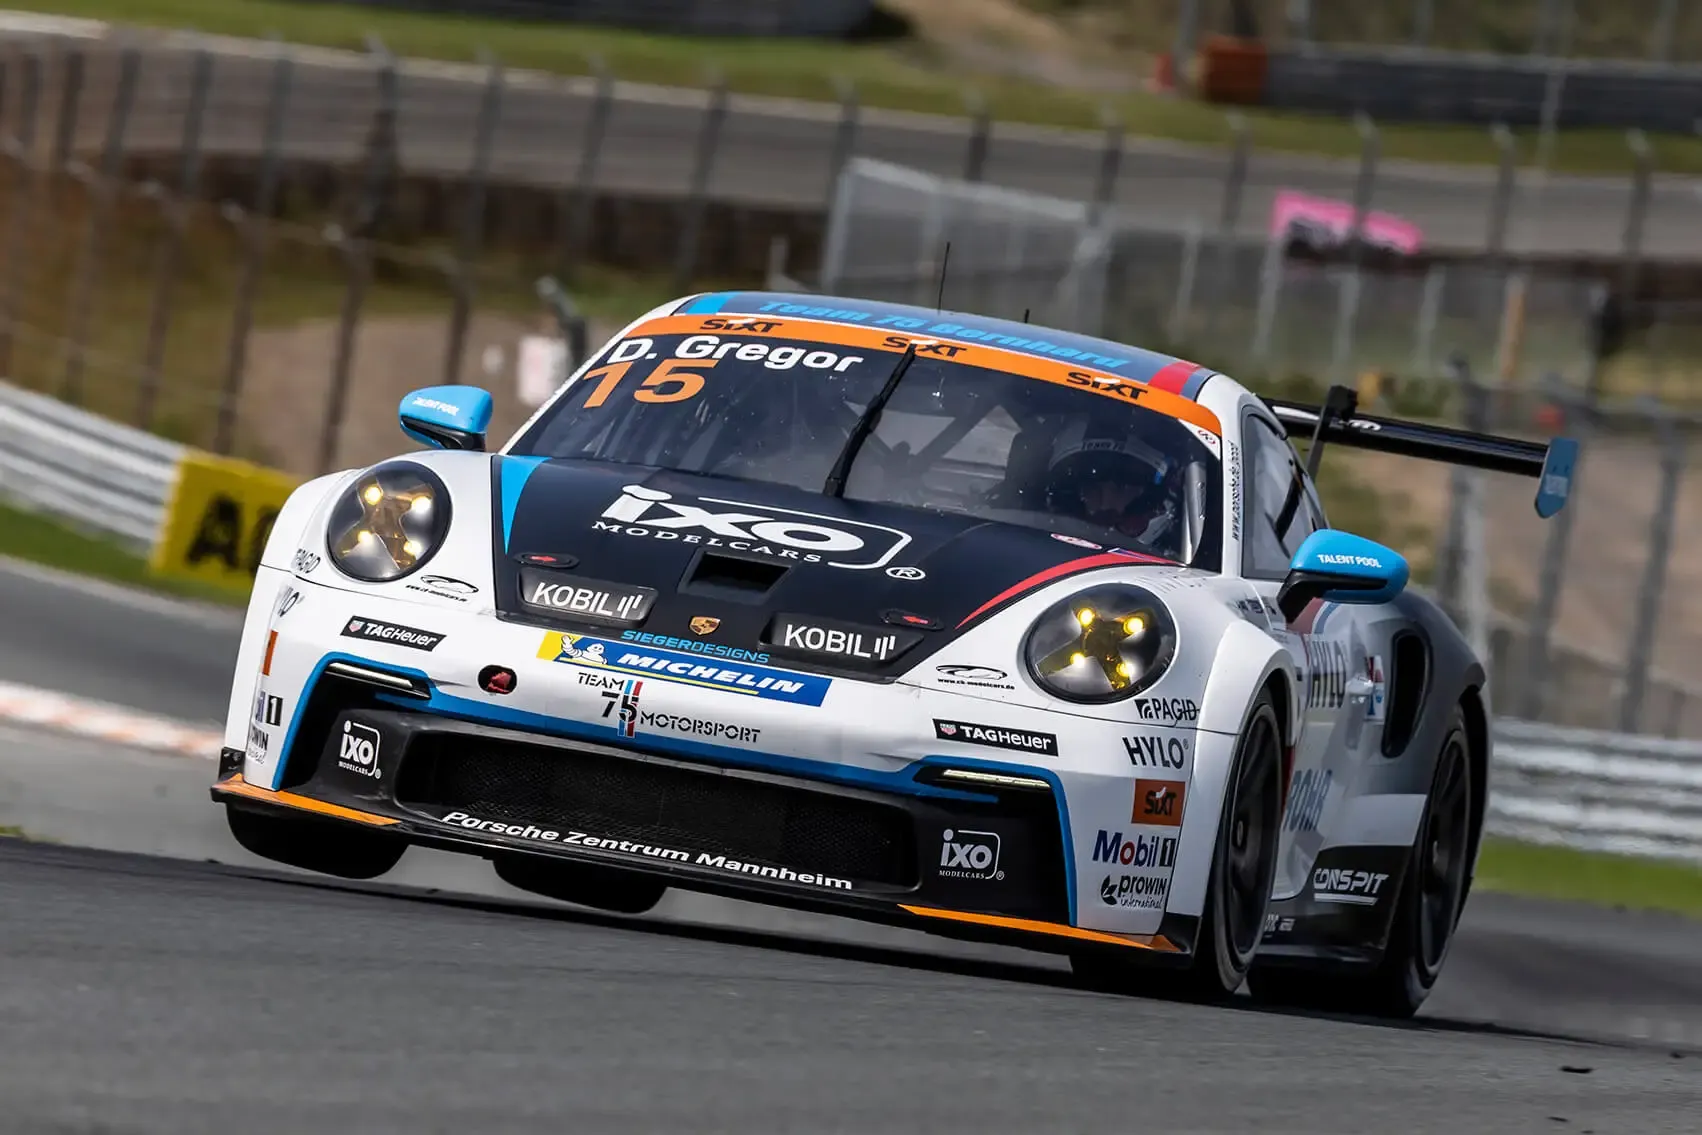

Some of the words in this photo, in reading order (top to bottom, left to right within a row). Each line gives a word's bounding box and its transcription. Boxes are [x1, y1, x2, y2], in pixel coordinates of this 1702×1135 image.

[760, 301, 870, 321] Team
[928, 323, 1132, 369] Bernhard
[606, 338, 656, 365] D.
[675, 335, 865, 373] Gregor
[583, 359, 719, 409] 15
[602, 484, 864, 551] ixo
[592, 520, 821, 563] MODELCARS
[1317, 553, 1356, 564] TALENT
[1355, 556, 1382, 568] POOL
[532, 582, 613, 617] KOBIL
[621, 630, 770, 664] SIEGERDESIGNS
[784, 624, 873, 659] KOBIL
[578, 672, 625, 690] TEAM
[617, 652, 805, 695] MICHELIN
[601, 691, 639, 723] 75
[1151, 698, 1197, 720] PAGID
[340, 720, 374, 765] ixo
[640, 710, 760, 743] MOTORSPORT
[1122, 736, 1185, 769] HYLO
[442, 811, 560, 841] Porsche
[563, 831, 690, 862] Zentrum
[695, 852, 852, 890] Mannheim
[941, 829, 993, 869] ixo
[1092, 829, 1159, 868] Mobil
[939, 870, 985, 880] MODELCARS
[1313, 868, 1389, 894] CONSPIT
